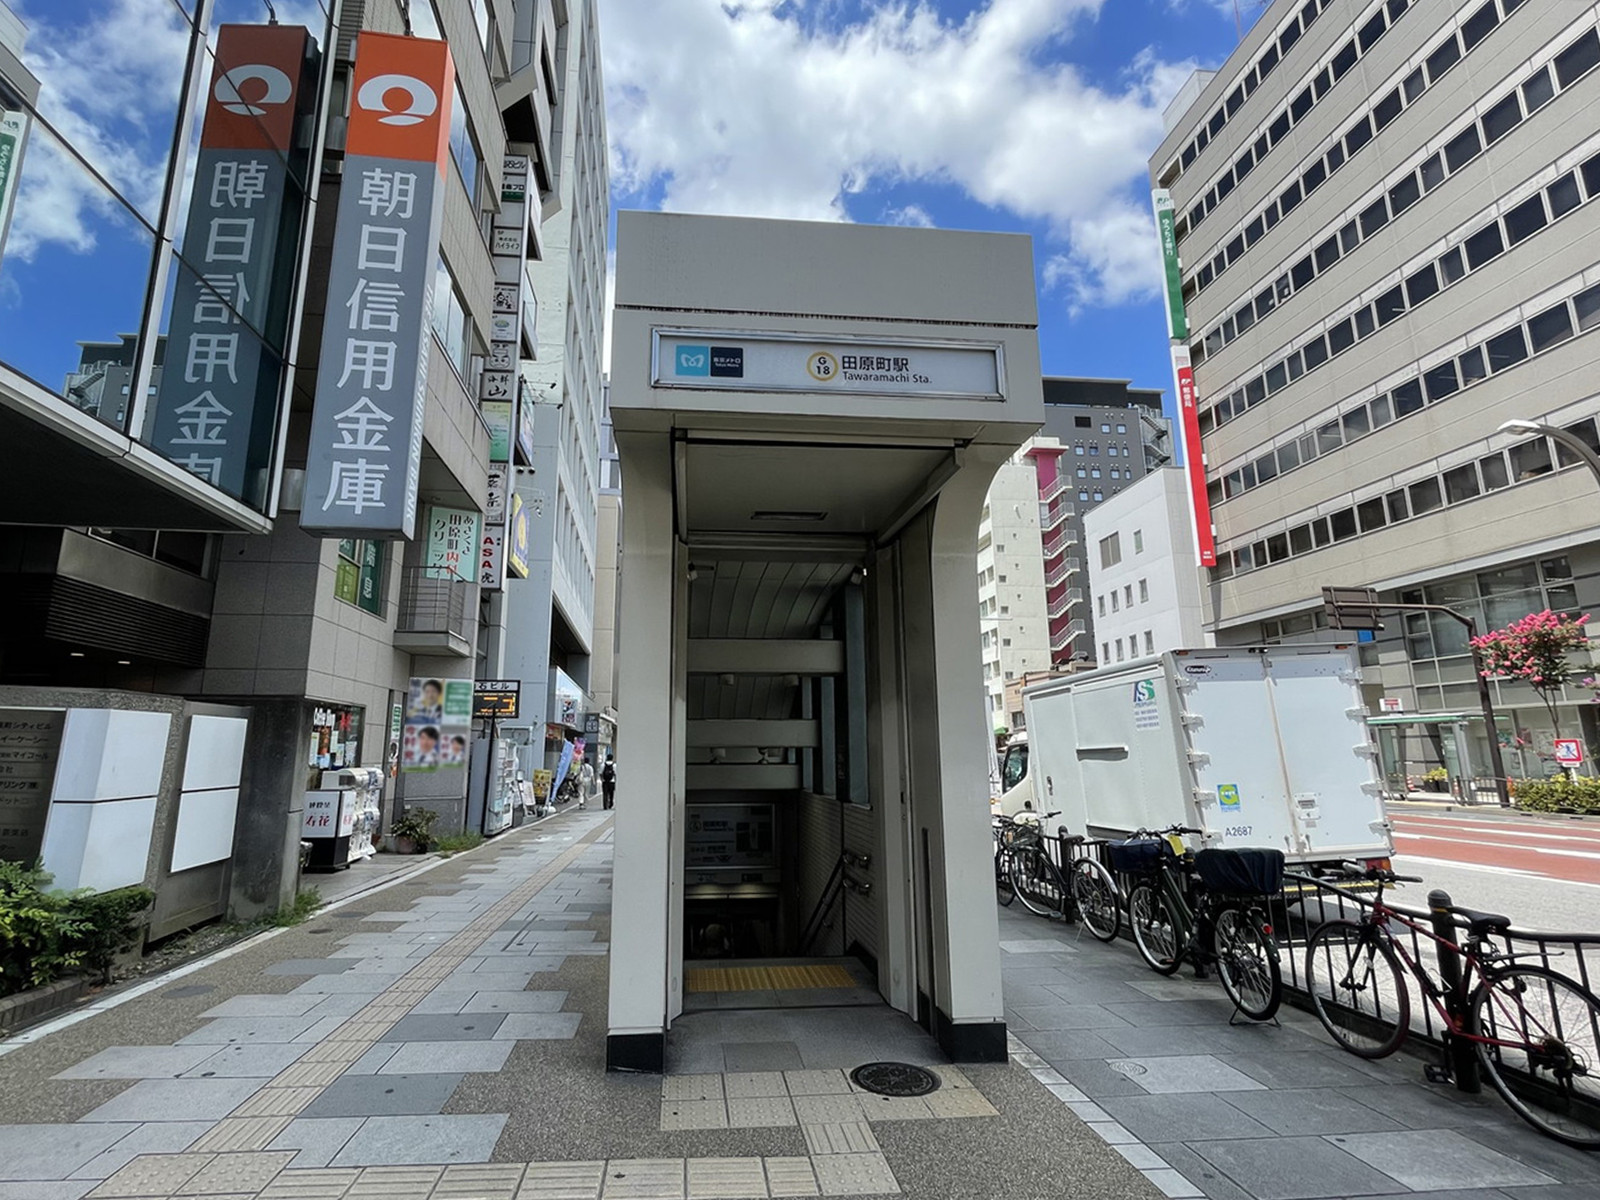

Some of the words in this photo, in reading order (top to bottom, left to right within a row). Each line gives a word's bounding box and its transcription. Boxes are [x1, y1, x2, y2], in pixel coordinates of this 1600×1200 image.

[322, 168, 418, 516] 朝日信用金庫
[418, 320, 430, 376] ASAHI
[818, 356, 827, 365] G
[842, 355, 909, 372] 田原町駅
[816, 366, 830, 375] 18
[842, 371, 910, 382] Tawaramachi
[912, 373, 932, 384] Sta.
[411, 380, 426, 460] SHINKIN
[405, 466, 419, 523] BANK
[462, 515, 474, 556] あさくさ
[474, 682, 510, 690] 石ビル
[1225, 825, 1253, 837] A2687
